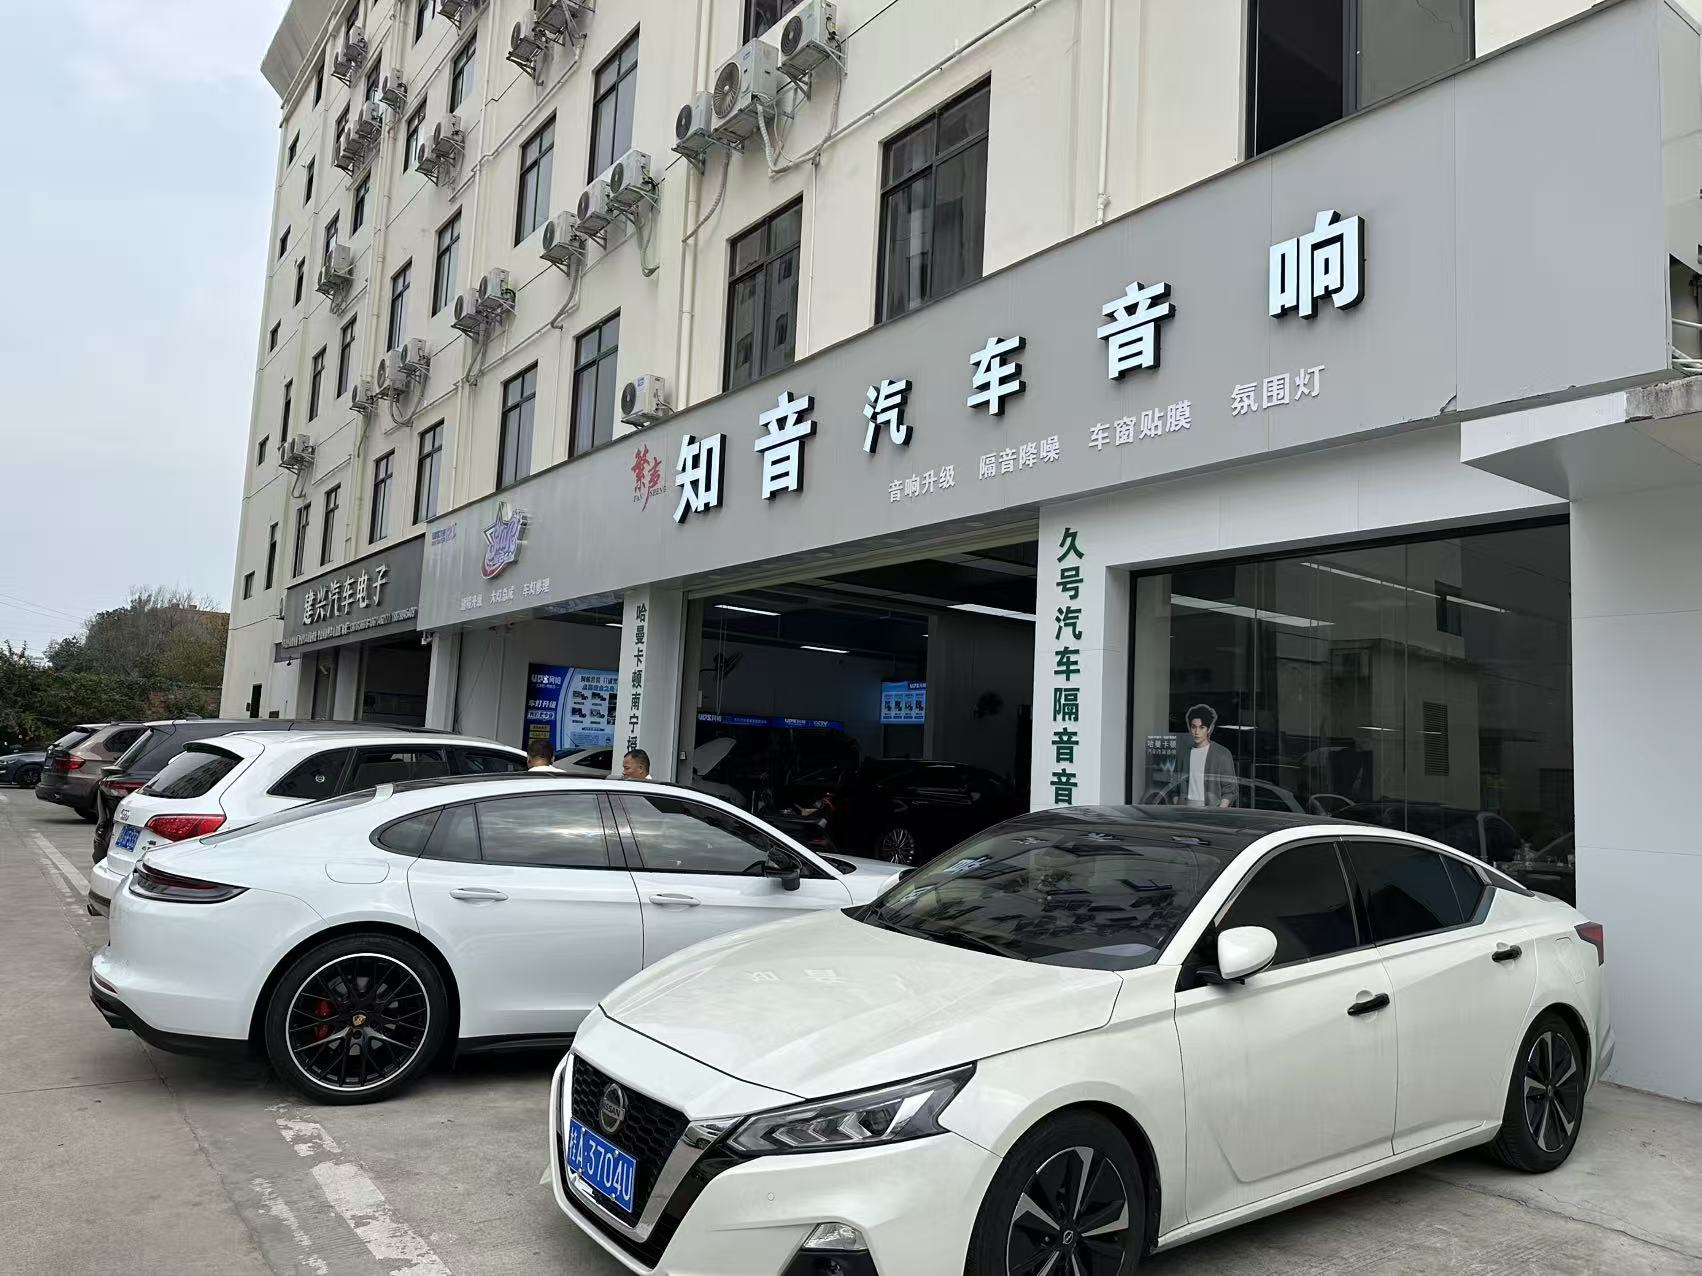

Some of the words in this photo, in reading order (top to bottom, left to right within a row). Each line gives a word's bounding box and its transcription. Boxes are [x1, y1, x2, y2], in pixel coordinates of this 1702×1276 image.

[673, 209, 1366, 524] 知音汽车音响
[888, 464, 956, 502] 音响升级
[978, 434, 1060, 480] 隔音降噪
[1088, 400, 1192, 451] 车窗贴膜
[1230, 364, 1326, 416] 氛围灯
[302, 563, 390, 625] 建兴汽车电子
[1049, 527, 1085, 805] 久号汽车隔音音
